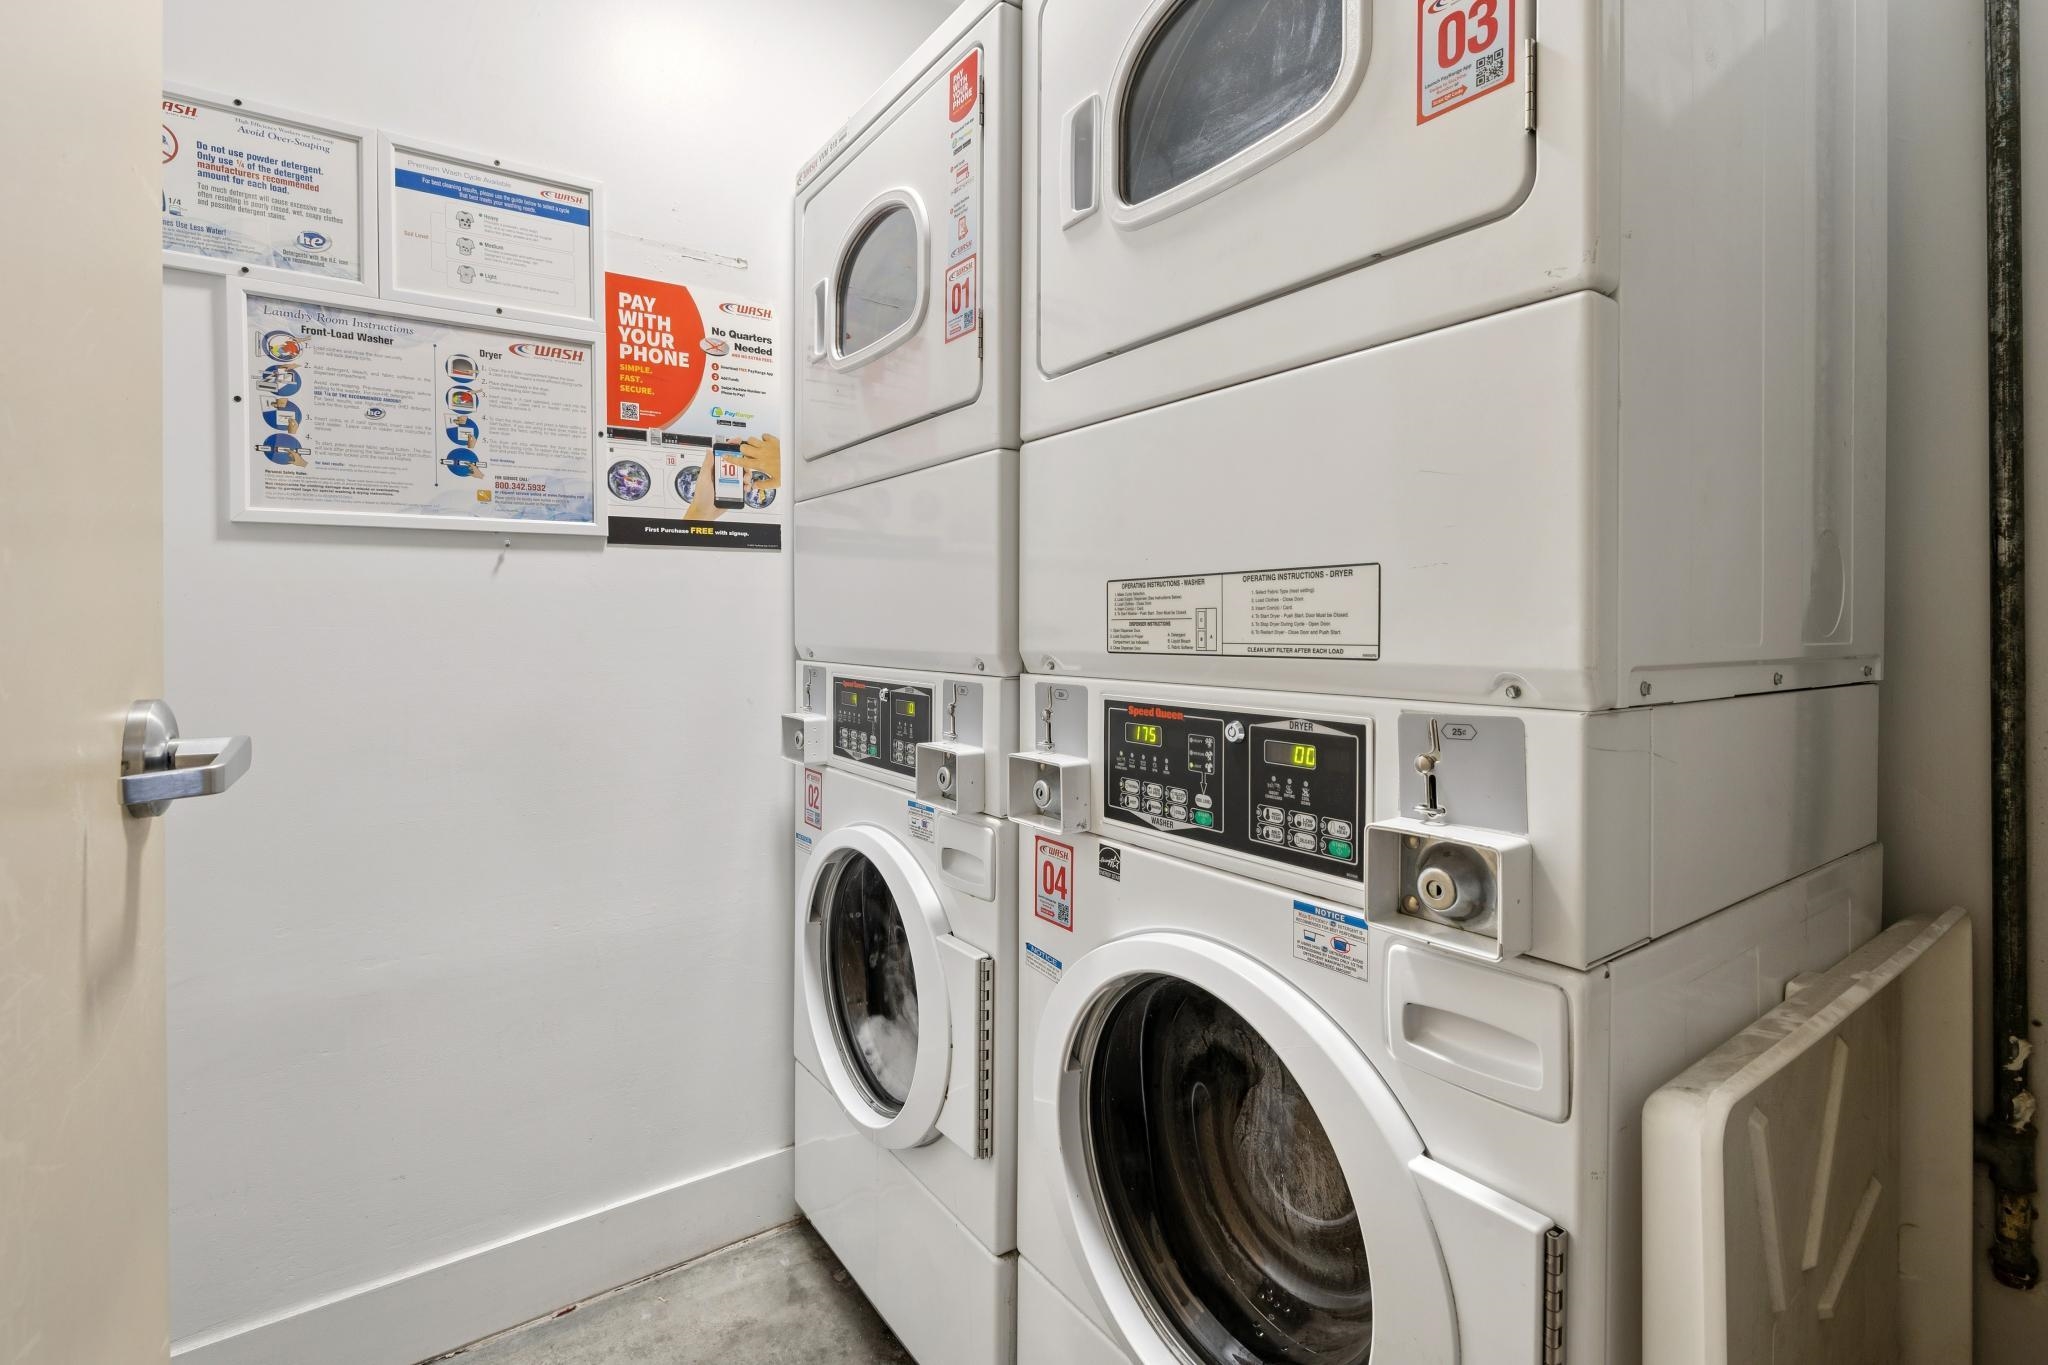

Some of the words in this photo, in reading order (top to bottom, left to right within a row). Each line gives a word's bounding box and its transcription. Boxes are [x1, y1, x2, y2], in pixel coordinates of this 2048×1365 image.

[1438, 0, 1499, 69] 03
[953, 87, 973, 111] PHONE
[162, 101, 197, 117] ASH
[238, 126, 265, 138] Avoid
[268, 132, 330, 154] Over-Soaping
[197, 141, 208, 151] Do
[211, 145, 226, 155] not
[229, 150, 244, 158] use
[247, 153, 278, 166] powder
[281, 160, 324, 175] detergent.
[197, 151, 216, 163] Only
[219, 157, 234, 166] use
[258, 165, 272, 174] the
[274, 168, 313, 182] detergent
[408, 160, 440, 172] Premium
[441, 167, 462, 177] Wash
[464, 172, 482, 183] Cycle
[197, 161, 260, 180] manufacturers
[263, 175, 320, 192] recommended
[197, 170, 230, 182] amount
[233, 176, 245, 185] for
[248, 181, 267, 190] each
[270, 184, 290, 195] load.
[431, 179, 441, 187] best
[442, 182, 462, 192] cleaning
[197, 182, 209, 191] Too
[211, 186, 228, 194] much
[229, 188, 258, 201] detergent
[272, 198, 288, 206] cause
[555, 192, 584, 205] WASH
[197, 191, 213, 199] often
[215, 194, 242, 206] resulting
[324, 215, 344, 224] clothes
[197, 198, 209, 207] and
[211, 202, 236, 211] possible
[238, 207, 266, 218] detergent
[176, 221, 188, 230] Use
[190, 223, 205, 233] Less
[206, 226, 227, 237] Water!
[484, 242, 504, 250] Medium
[618, 292, 656, 313] PAY
[952, 277, 970, 315] 01
[264, 305, 312, 323] Laundry
[316, 312, 349, 326] Room
[352, 318, 416, 336] Instructions
[618, 309, 671, 332] WITH
[736, 306, 773, 319] WASH
[301, 325, 354, 341] Front-Load
[357, 333, 394, 345] Washer
[618, 326, 675, 350] YOUR
[711, 327, 726, 337] No
[729, 330, 773, 345] Quarters
[480, 349, 503, 361] Dryer
[535, 344, 584, 362] WASH
[619, 344, 690, 368] PHONE
[734, 343, 773, 357] Needed
[620, 364, 653, 374] SIMPLE.
[620, 374, 643, 384] FAST.
[620, 385, 655, 395] SECURE.
[667, 457, 675, 465] 10
[721, 464, 736, 477] 10
[495, 482, 546, 492] 800.342.5932
[690, 527, 714, 535] FREE
[1243, 574, 1276, 583] OPERATING
[1277, 571, 1324, 581] INSTRUCTIONS
[1330, 569, 1354, 578] DRYER
[1122, 582, 1146, 590] OPERATING
[1147, 580, 1181, 589] INSTRUCTIONS
[1128, 705, 1155, 718] Speed
[1156, 708, 1185, 720] Queen
[1136, 726, 1156, 742] 175
[1290, 720, 1314, 732] DRYER
[1452, 728, 1467, 736] 25¢
[808, 784, 819, 810] 02
[1151, 816, 1174, 829] WASHER
[1048, 847, 1068, 860] WASH
[1043, 861, 1068, 901] 04
[1315, 907, 1345, 922] NOTICE
[1337, 924, 1359, 933] DETERGENT
[1339, 929, 1366, 941] PERFORMANCE
[1031, 945, 1057, 968] NOTICE
